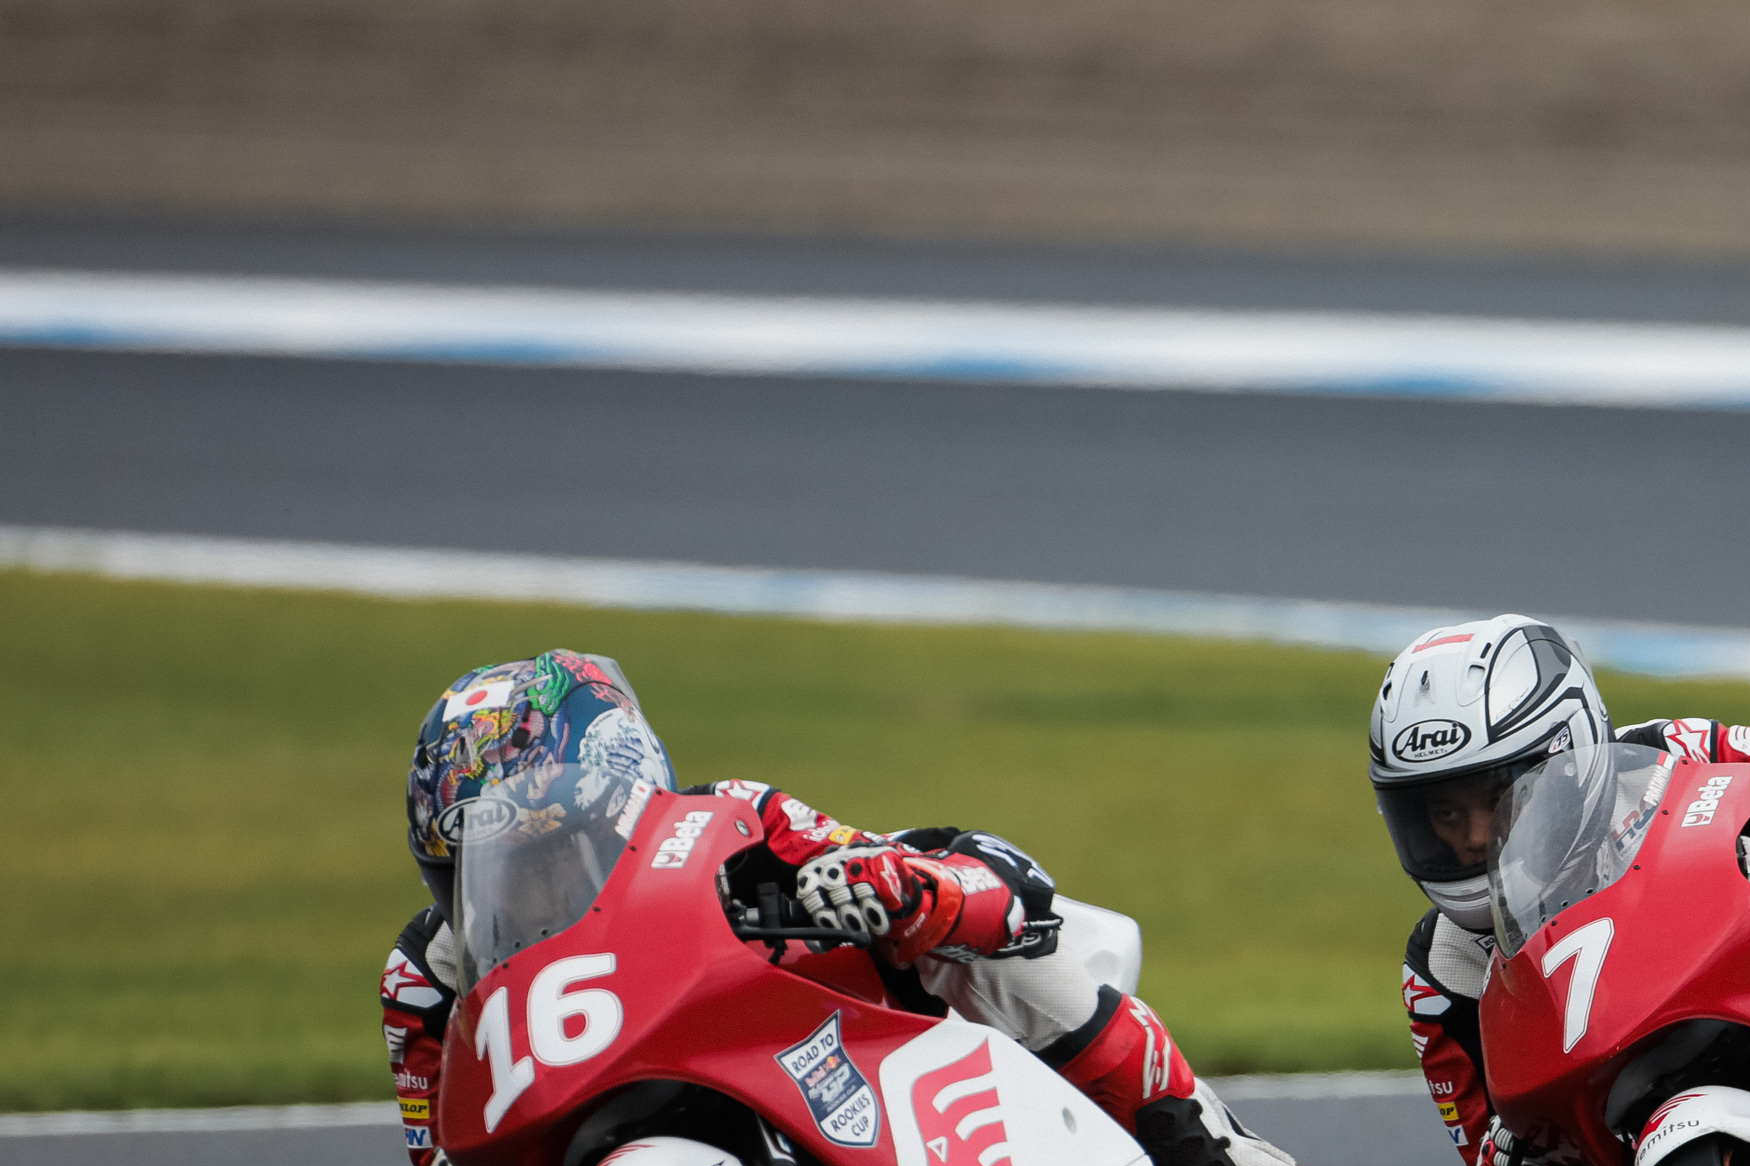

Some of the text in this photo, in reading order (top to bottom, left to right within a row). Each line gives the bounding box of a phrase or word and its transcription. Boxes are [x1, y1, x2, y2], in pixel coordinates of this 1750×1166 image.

[1397, 722, 1461, 755] Arai
[1686, 776, 1733, 814] Beta
[659, 811, 714, 852] Beta
[1540, 916, 1615, 1054] 7
[474, 951, 624, 1134] 16
[791, 1033, 834, 1072] ROAD TO
[830, 1093, 870, 1132] ROOKIES
[851, 1115, 869, 1137] CUP
